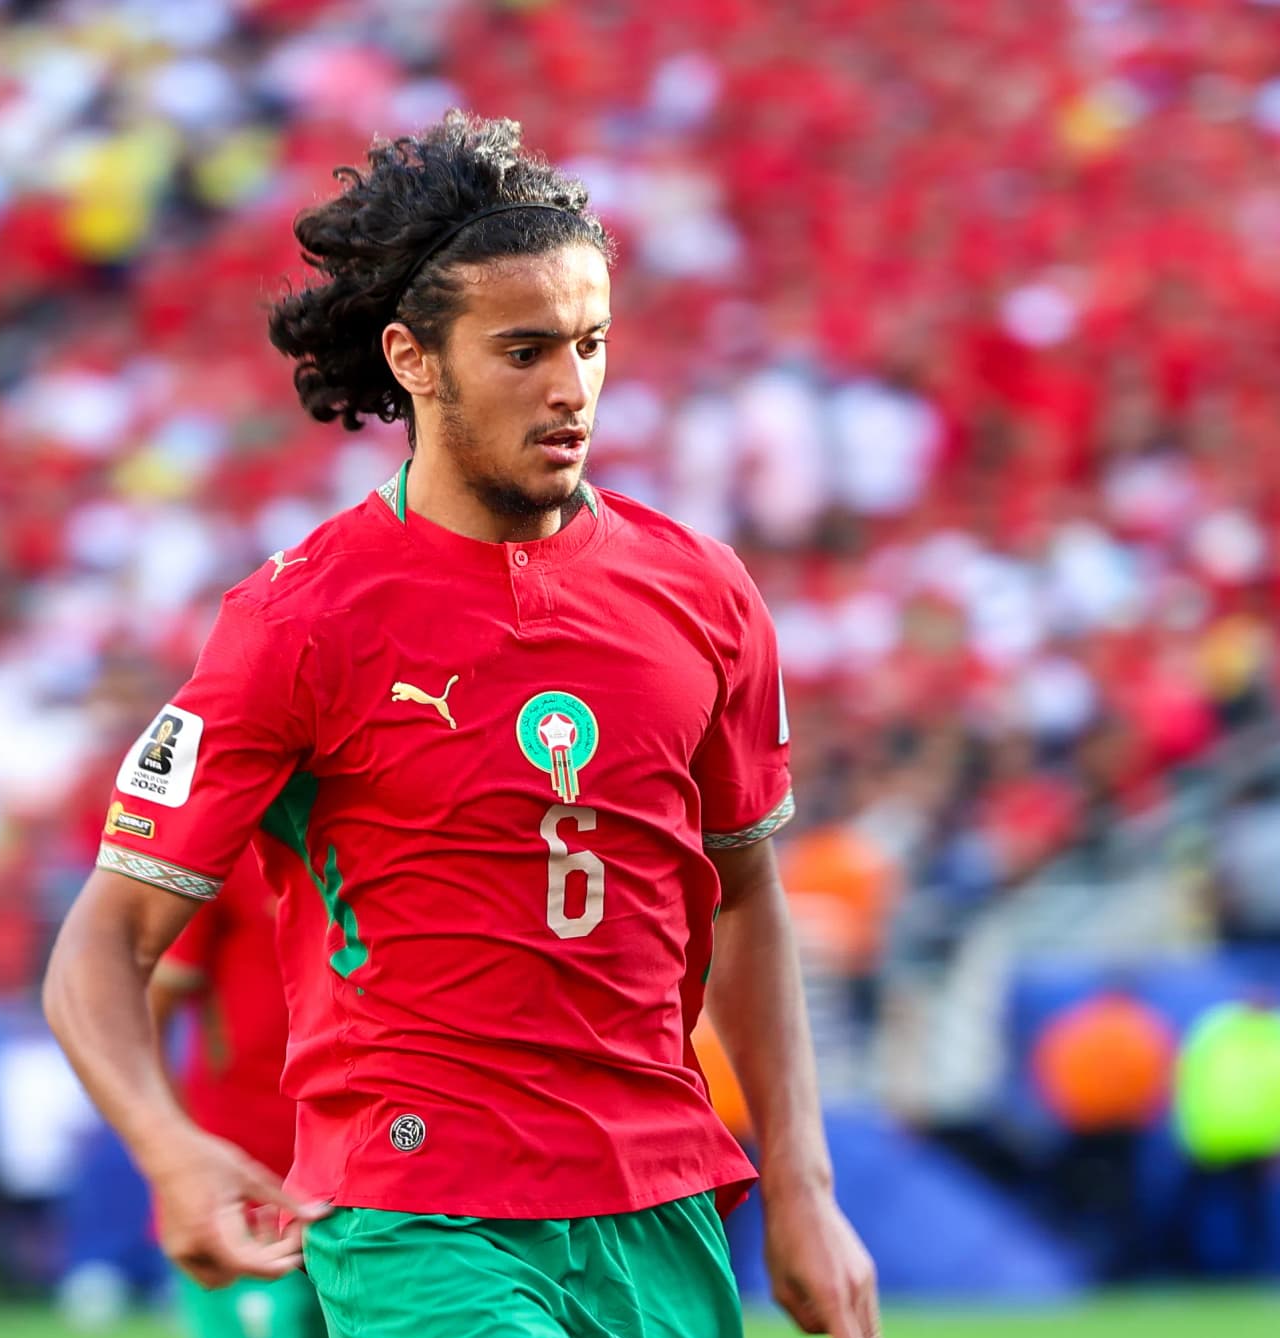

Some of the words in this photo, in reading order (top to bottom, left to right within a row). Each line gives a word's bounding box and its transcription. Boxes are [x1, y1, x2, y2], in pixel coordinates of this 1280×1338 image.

[144, 758, 162, 771] FIFA
[130, 777, 167, 795] 2026
[134, 771, 156, 782] WORLD
[156, 777, 169, 785] CUP
[539, 804, 605, 939] 6
